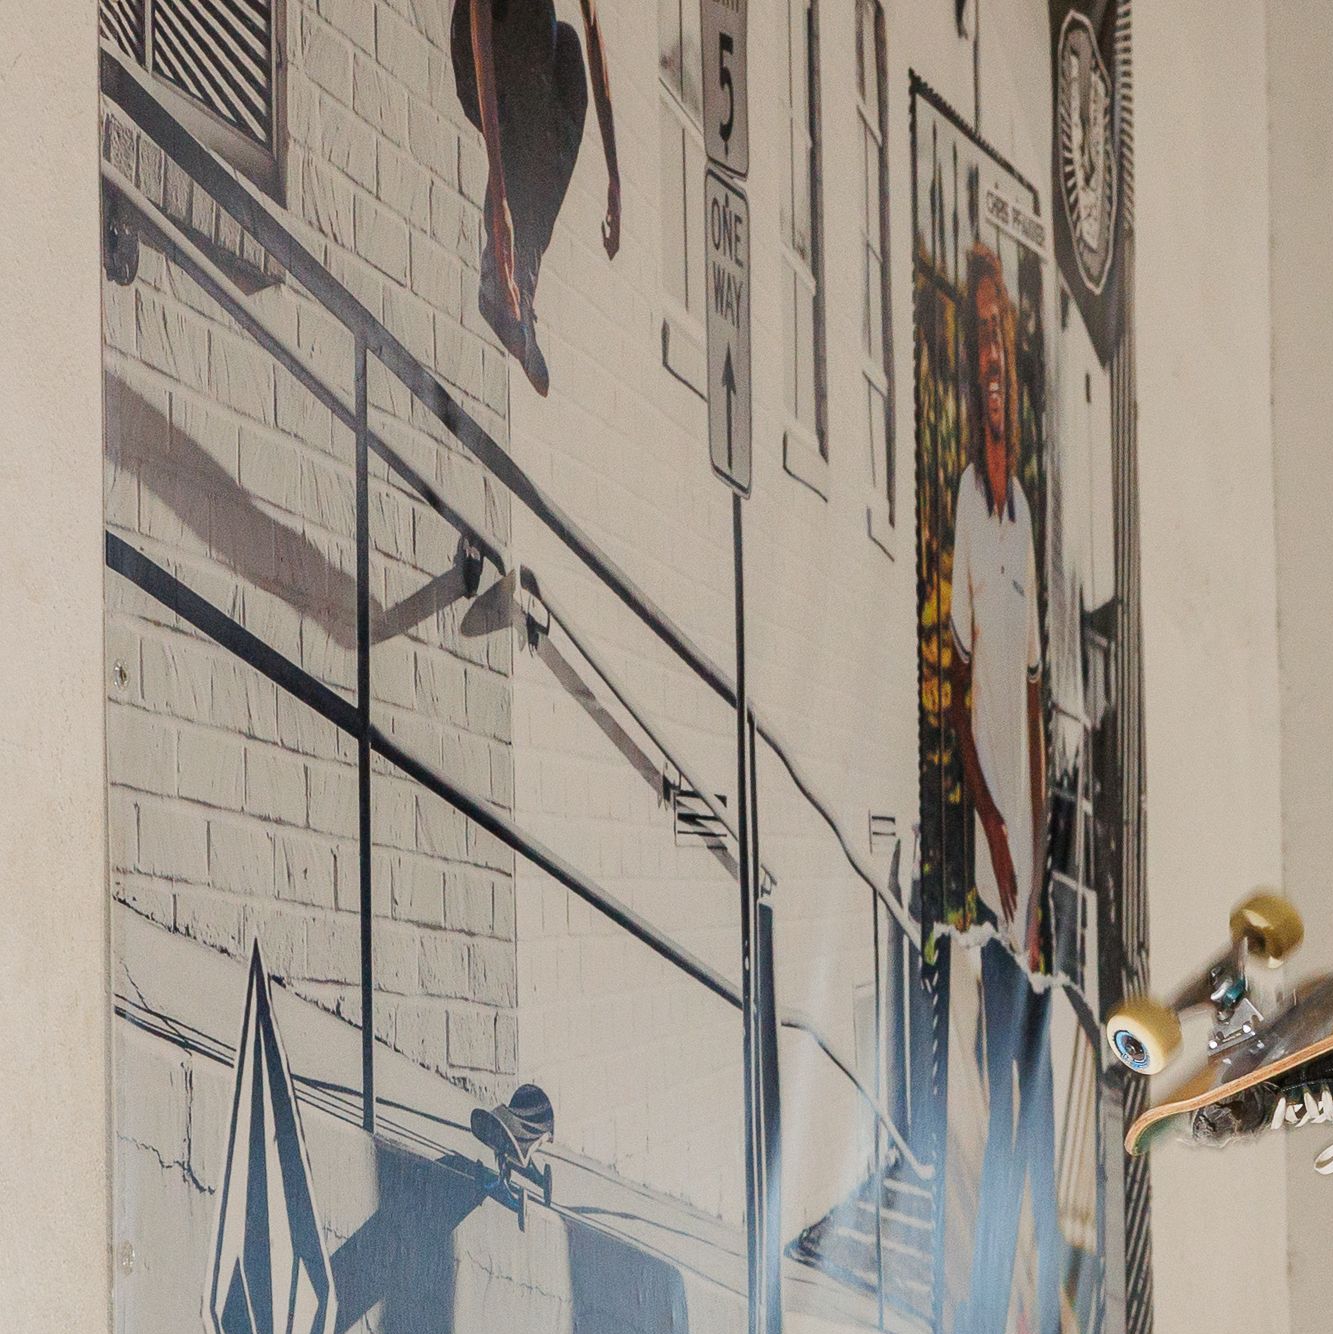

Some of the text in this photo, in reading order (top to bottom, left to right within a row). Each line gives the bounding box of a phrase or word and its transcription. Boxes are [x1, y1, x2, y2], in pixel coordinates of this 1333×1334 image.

[719, 32, 735, 143] 5
[711, 197, 743, 269] ONE
[712, 260, 743, 330] WAY
